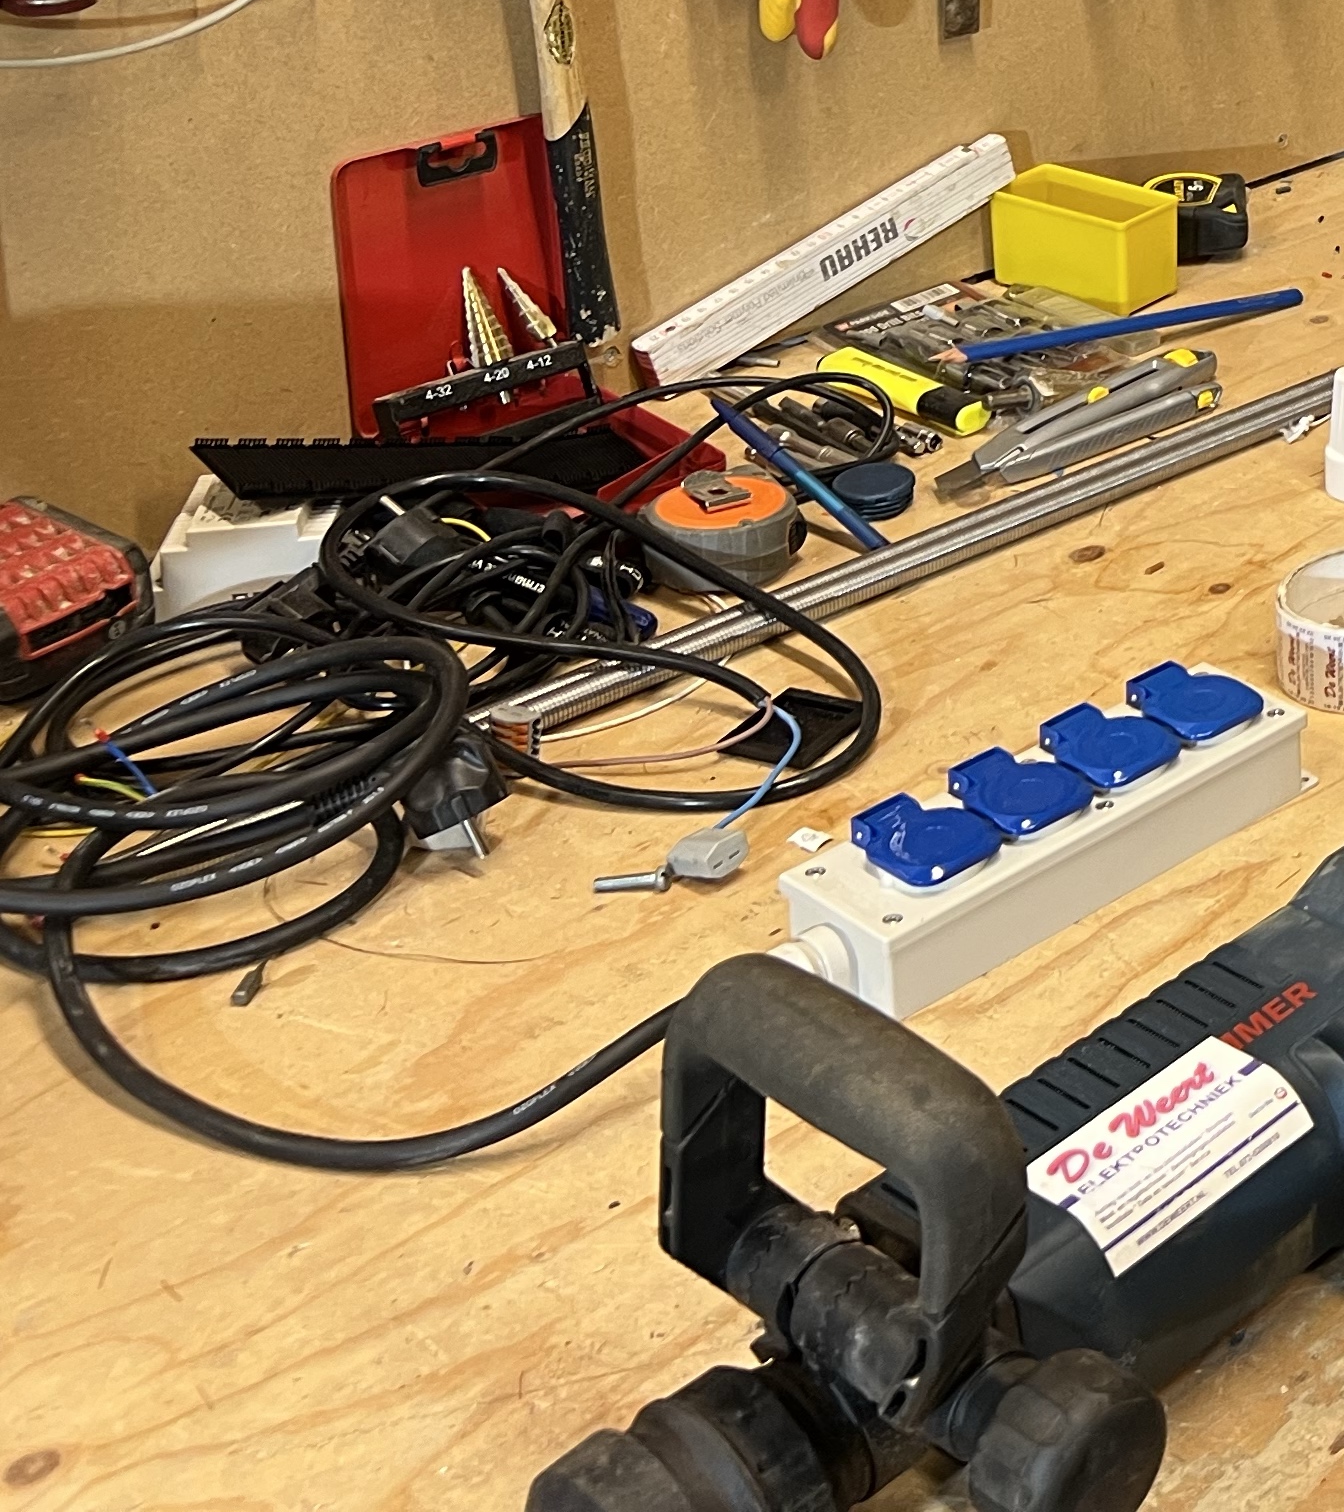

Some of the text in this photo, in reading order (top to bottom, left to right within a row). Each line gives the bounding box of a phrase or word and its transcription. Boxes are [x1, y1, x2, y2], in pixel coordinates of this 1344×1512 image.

[819, 216, 899, 282] REHAU
[526, 354, 552, 371] 4-12
[484, 367, 510, 383] 4-20
[425, 384, 453, 400] 4-32
[1046, 1141, 1113, 1184] De
[1108, 1062, 1215, 1138] Weert
